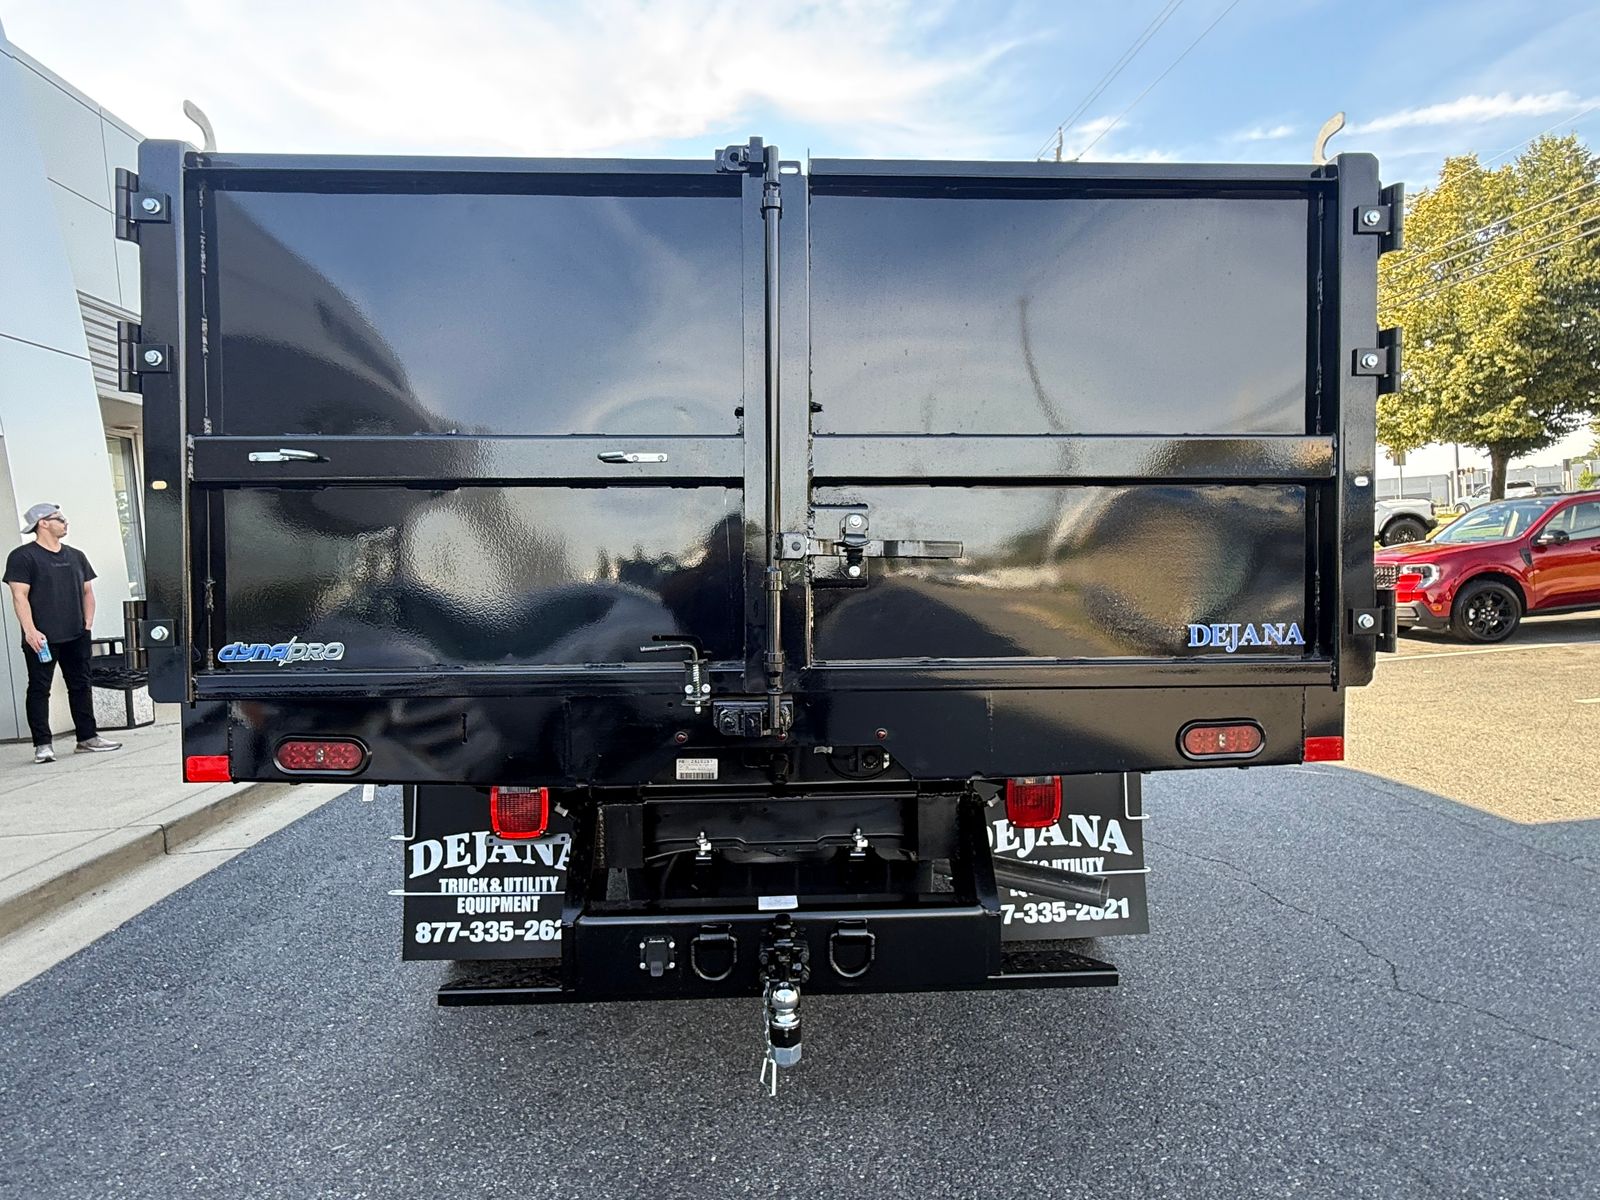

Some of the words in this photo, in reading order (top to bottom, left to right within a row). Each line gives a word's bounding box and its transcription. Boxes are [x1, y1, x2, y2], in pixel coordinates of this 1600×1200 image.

[1187, 622, 1306, 653] DEJANA
[986, 814, 1133, 858] EJANA
[457, 896, 541, 915] EQUIPMENT
